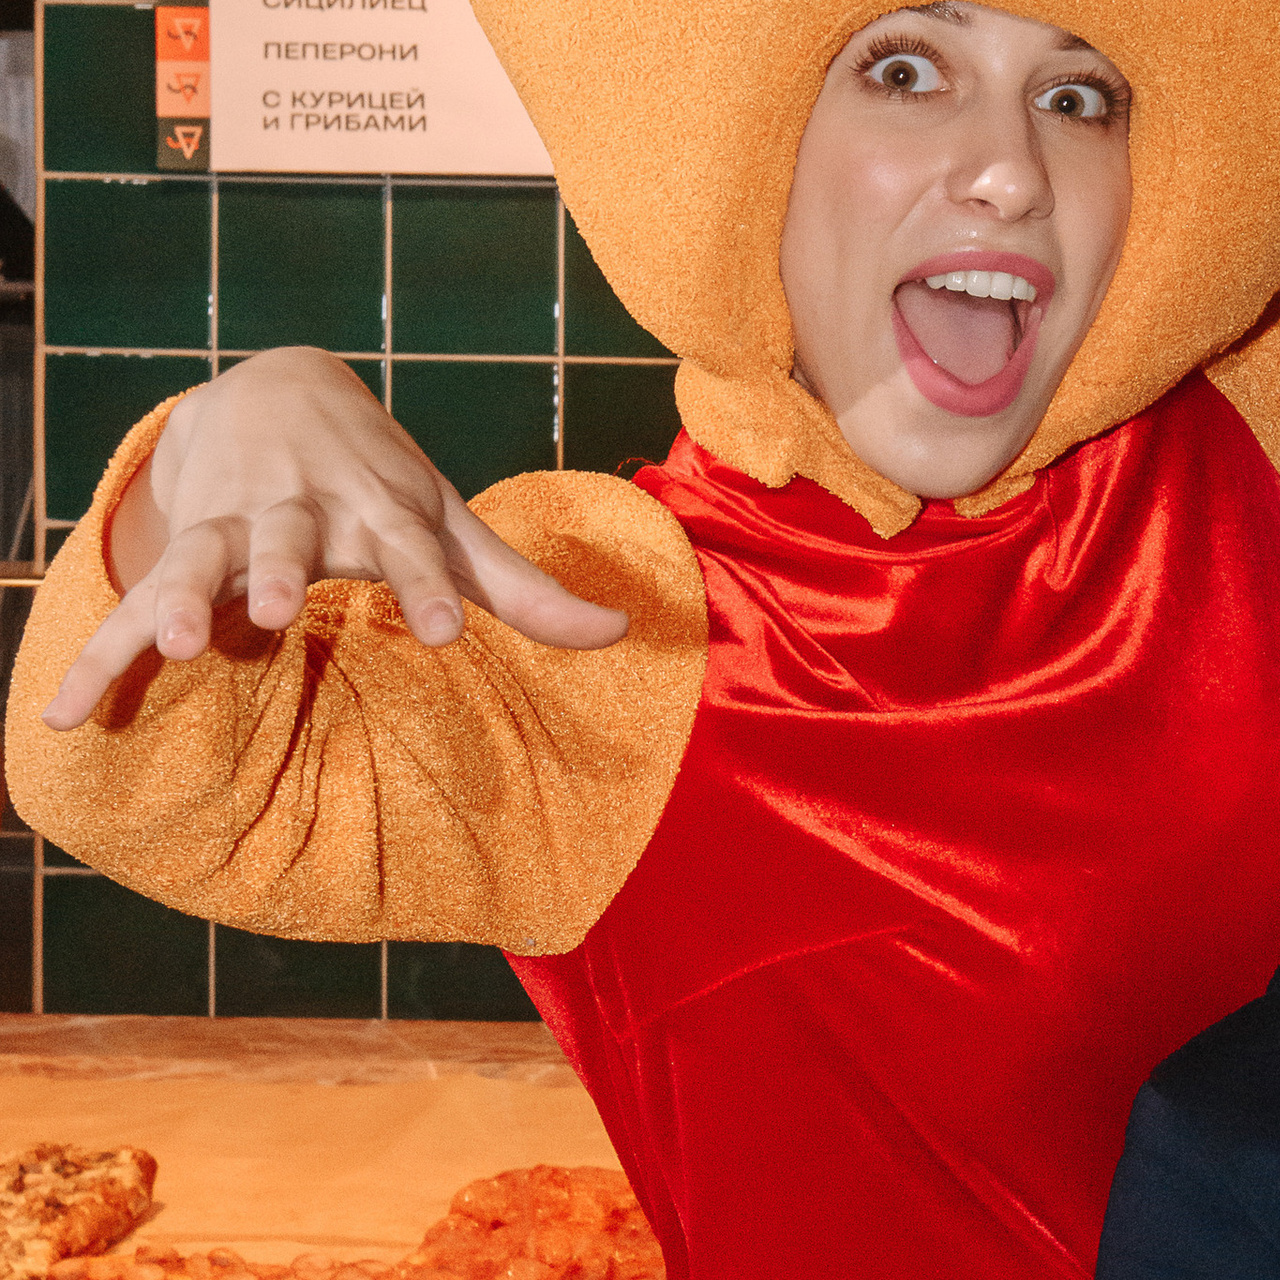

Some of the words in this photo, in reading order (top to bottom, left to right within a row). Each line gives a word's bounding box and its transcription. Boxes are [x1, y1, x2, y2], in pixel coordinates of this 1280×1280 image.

[263, 41, 419, 62] ПЕПЕРОНИ
[261, 89, 281, 109] С
[290, 87, 426, 111] КУРИЦЕЙ
[289, 112, 427, 132] ГРИБАМИ
